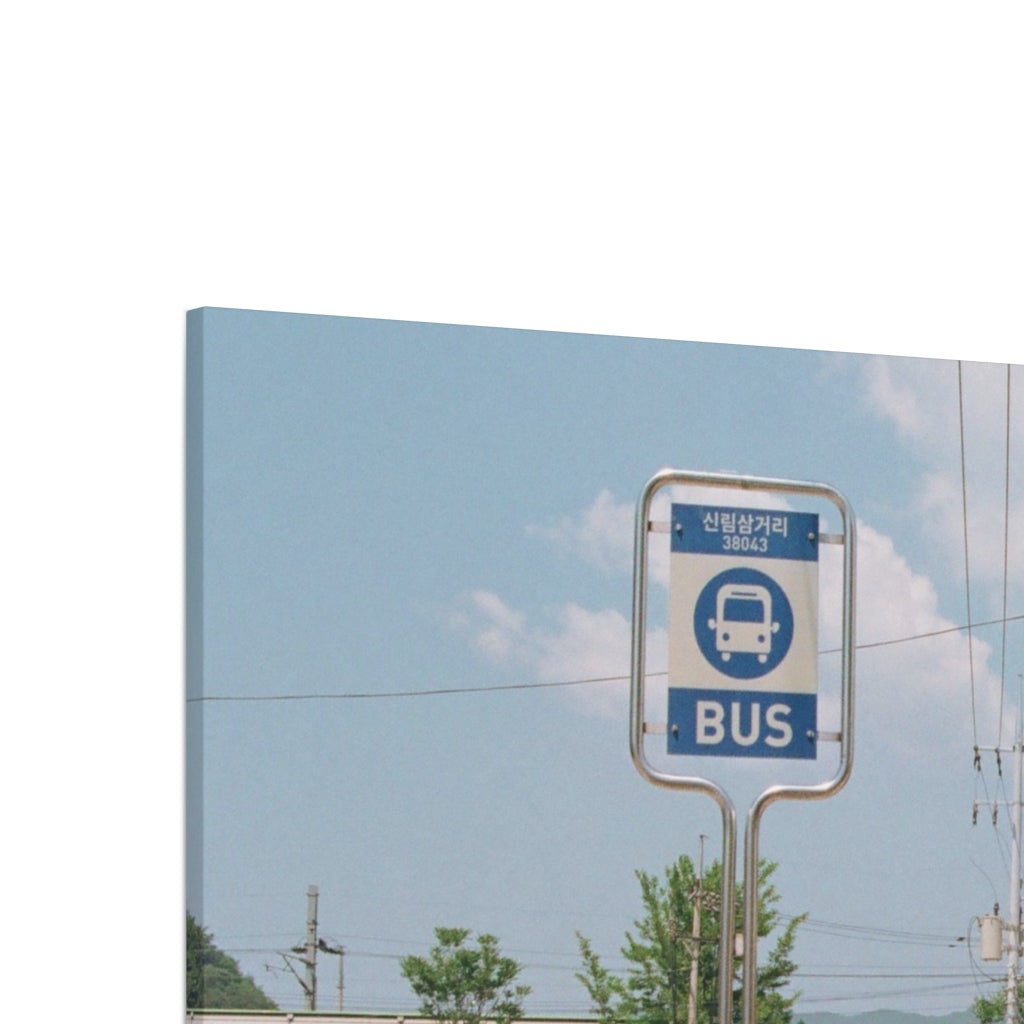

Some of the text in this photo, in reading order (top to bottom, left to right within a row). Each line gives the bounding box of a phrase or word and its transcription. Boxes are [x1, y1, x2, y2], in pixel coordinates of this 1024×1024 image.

[703, 511, 788, 537] 신림삼거리
[722, 535, 768, 552] 38043
[696, 700, 793, 747] BUS
